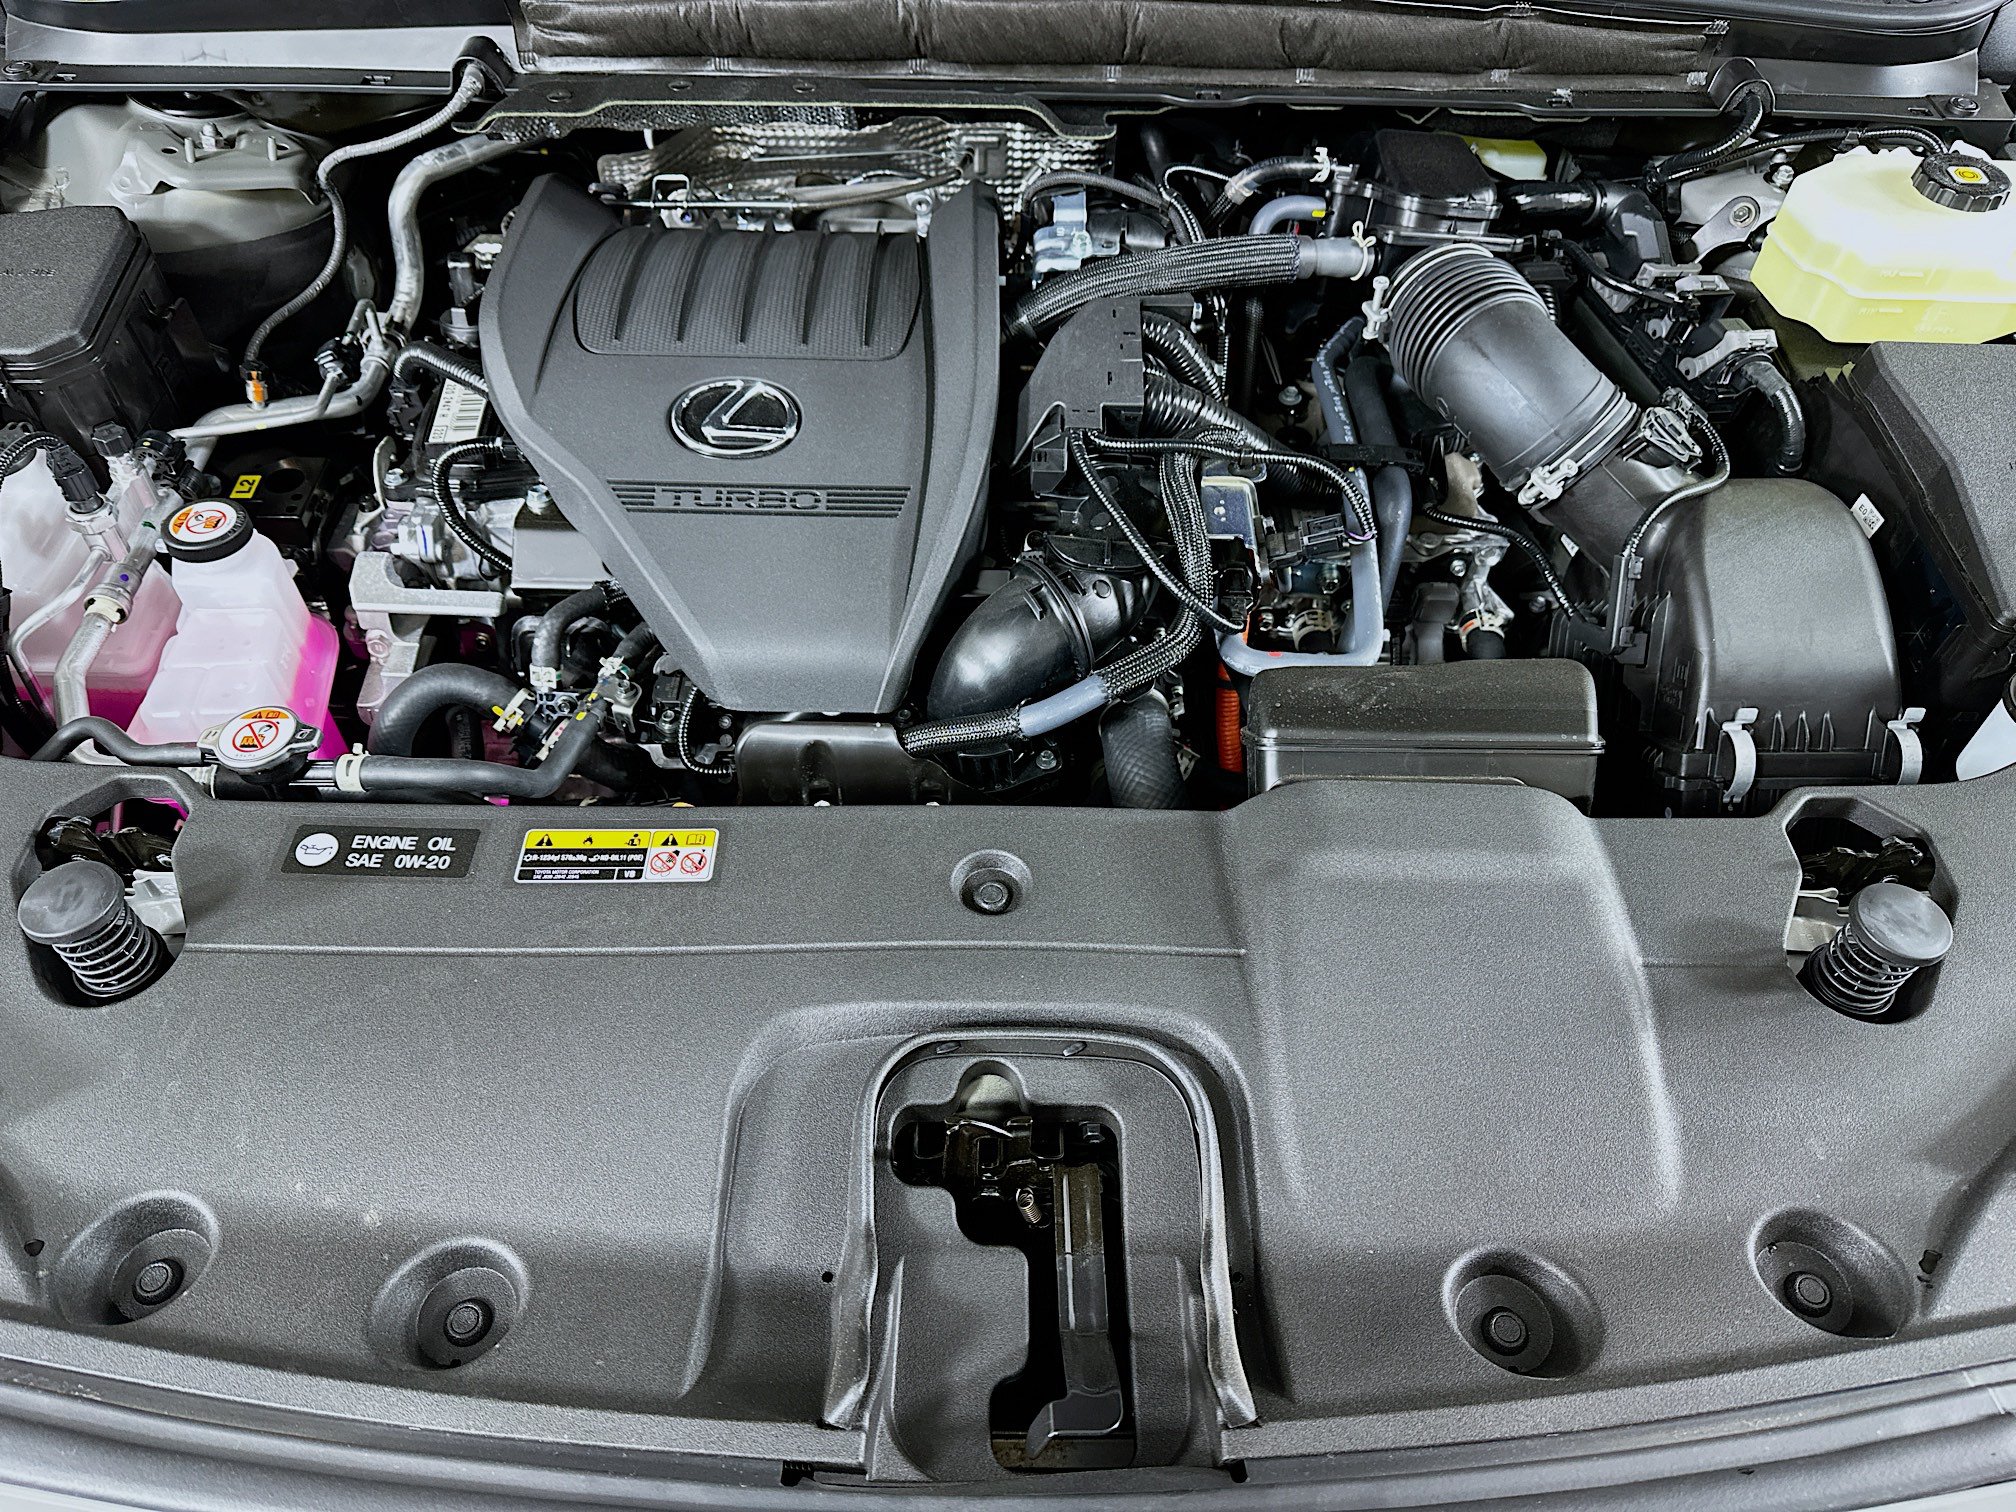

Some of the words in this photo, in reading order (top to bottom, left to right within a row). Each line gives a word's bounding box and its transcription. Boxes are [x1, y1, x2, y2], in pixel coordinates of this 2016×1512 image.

[235, 479, 257, 494] L2
[656, 488, 825, 510] TURBO
[351, 835, 419, 850] ENGINE
[427, 837, 456, 852] OIL
[345, 853, 384, 868] SAE
[393, 854, 451, 870] 0W-20
